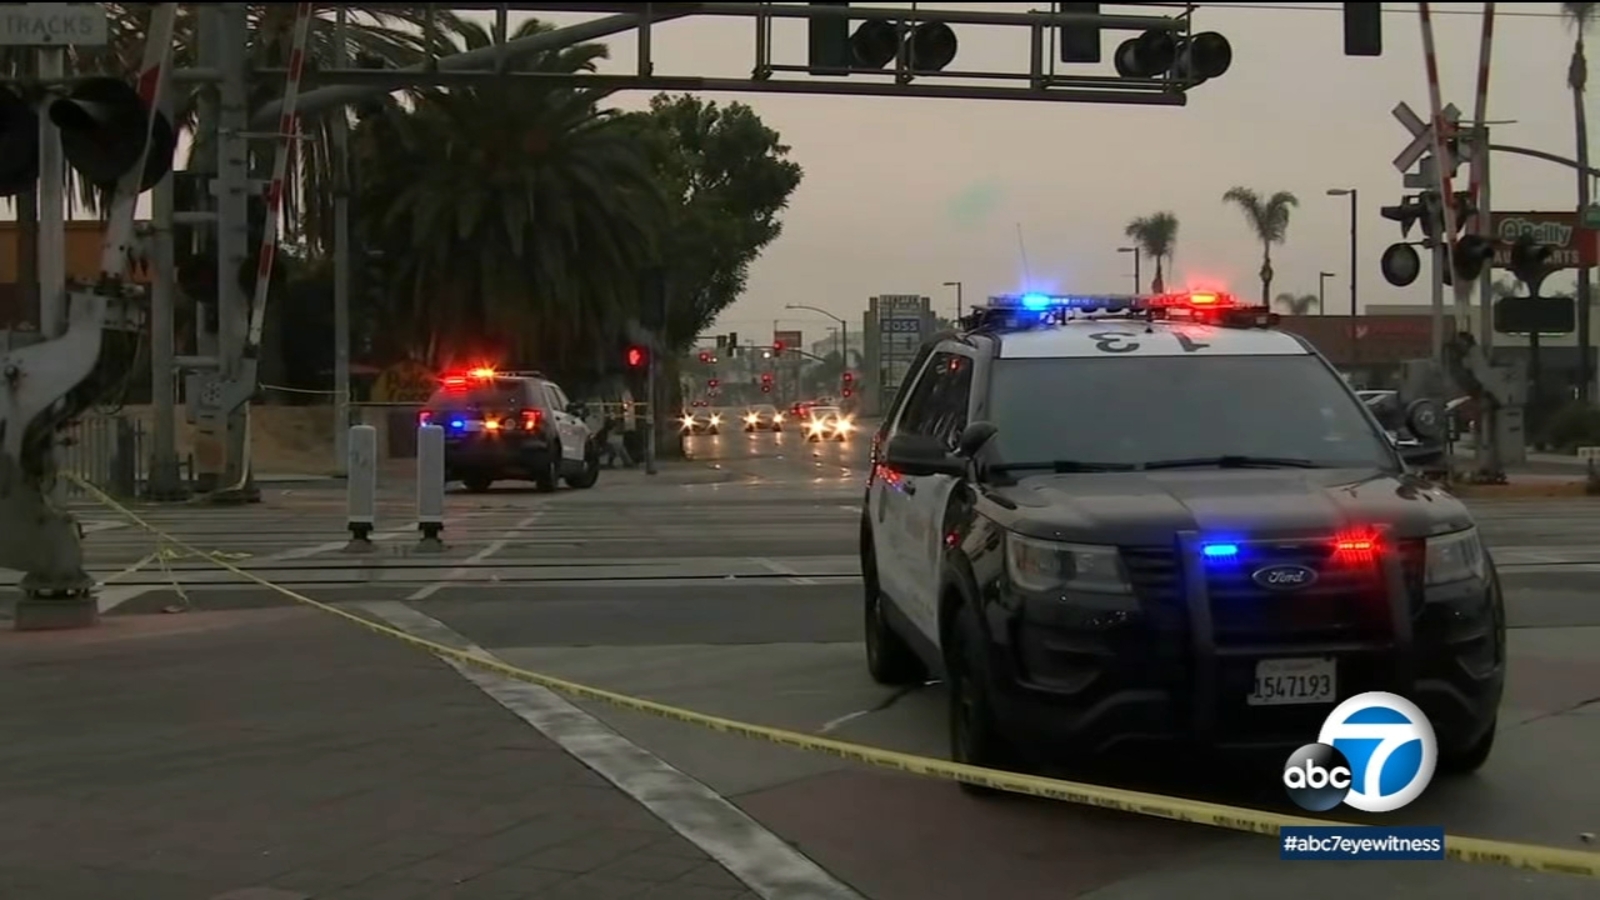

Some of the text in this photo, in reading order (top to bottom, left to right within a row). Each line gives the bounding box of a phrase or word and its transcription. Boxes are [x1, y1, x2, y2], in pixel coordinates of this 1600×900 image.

[7, 14, 93, 35] TRACKS
[1268, 570, 1305, 583] Ford
[1254, 674, 1331, 699] 1547193
